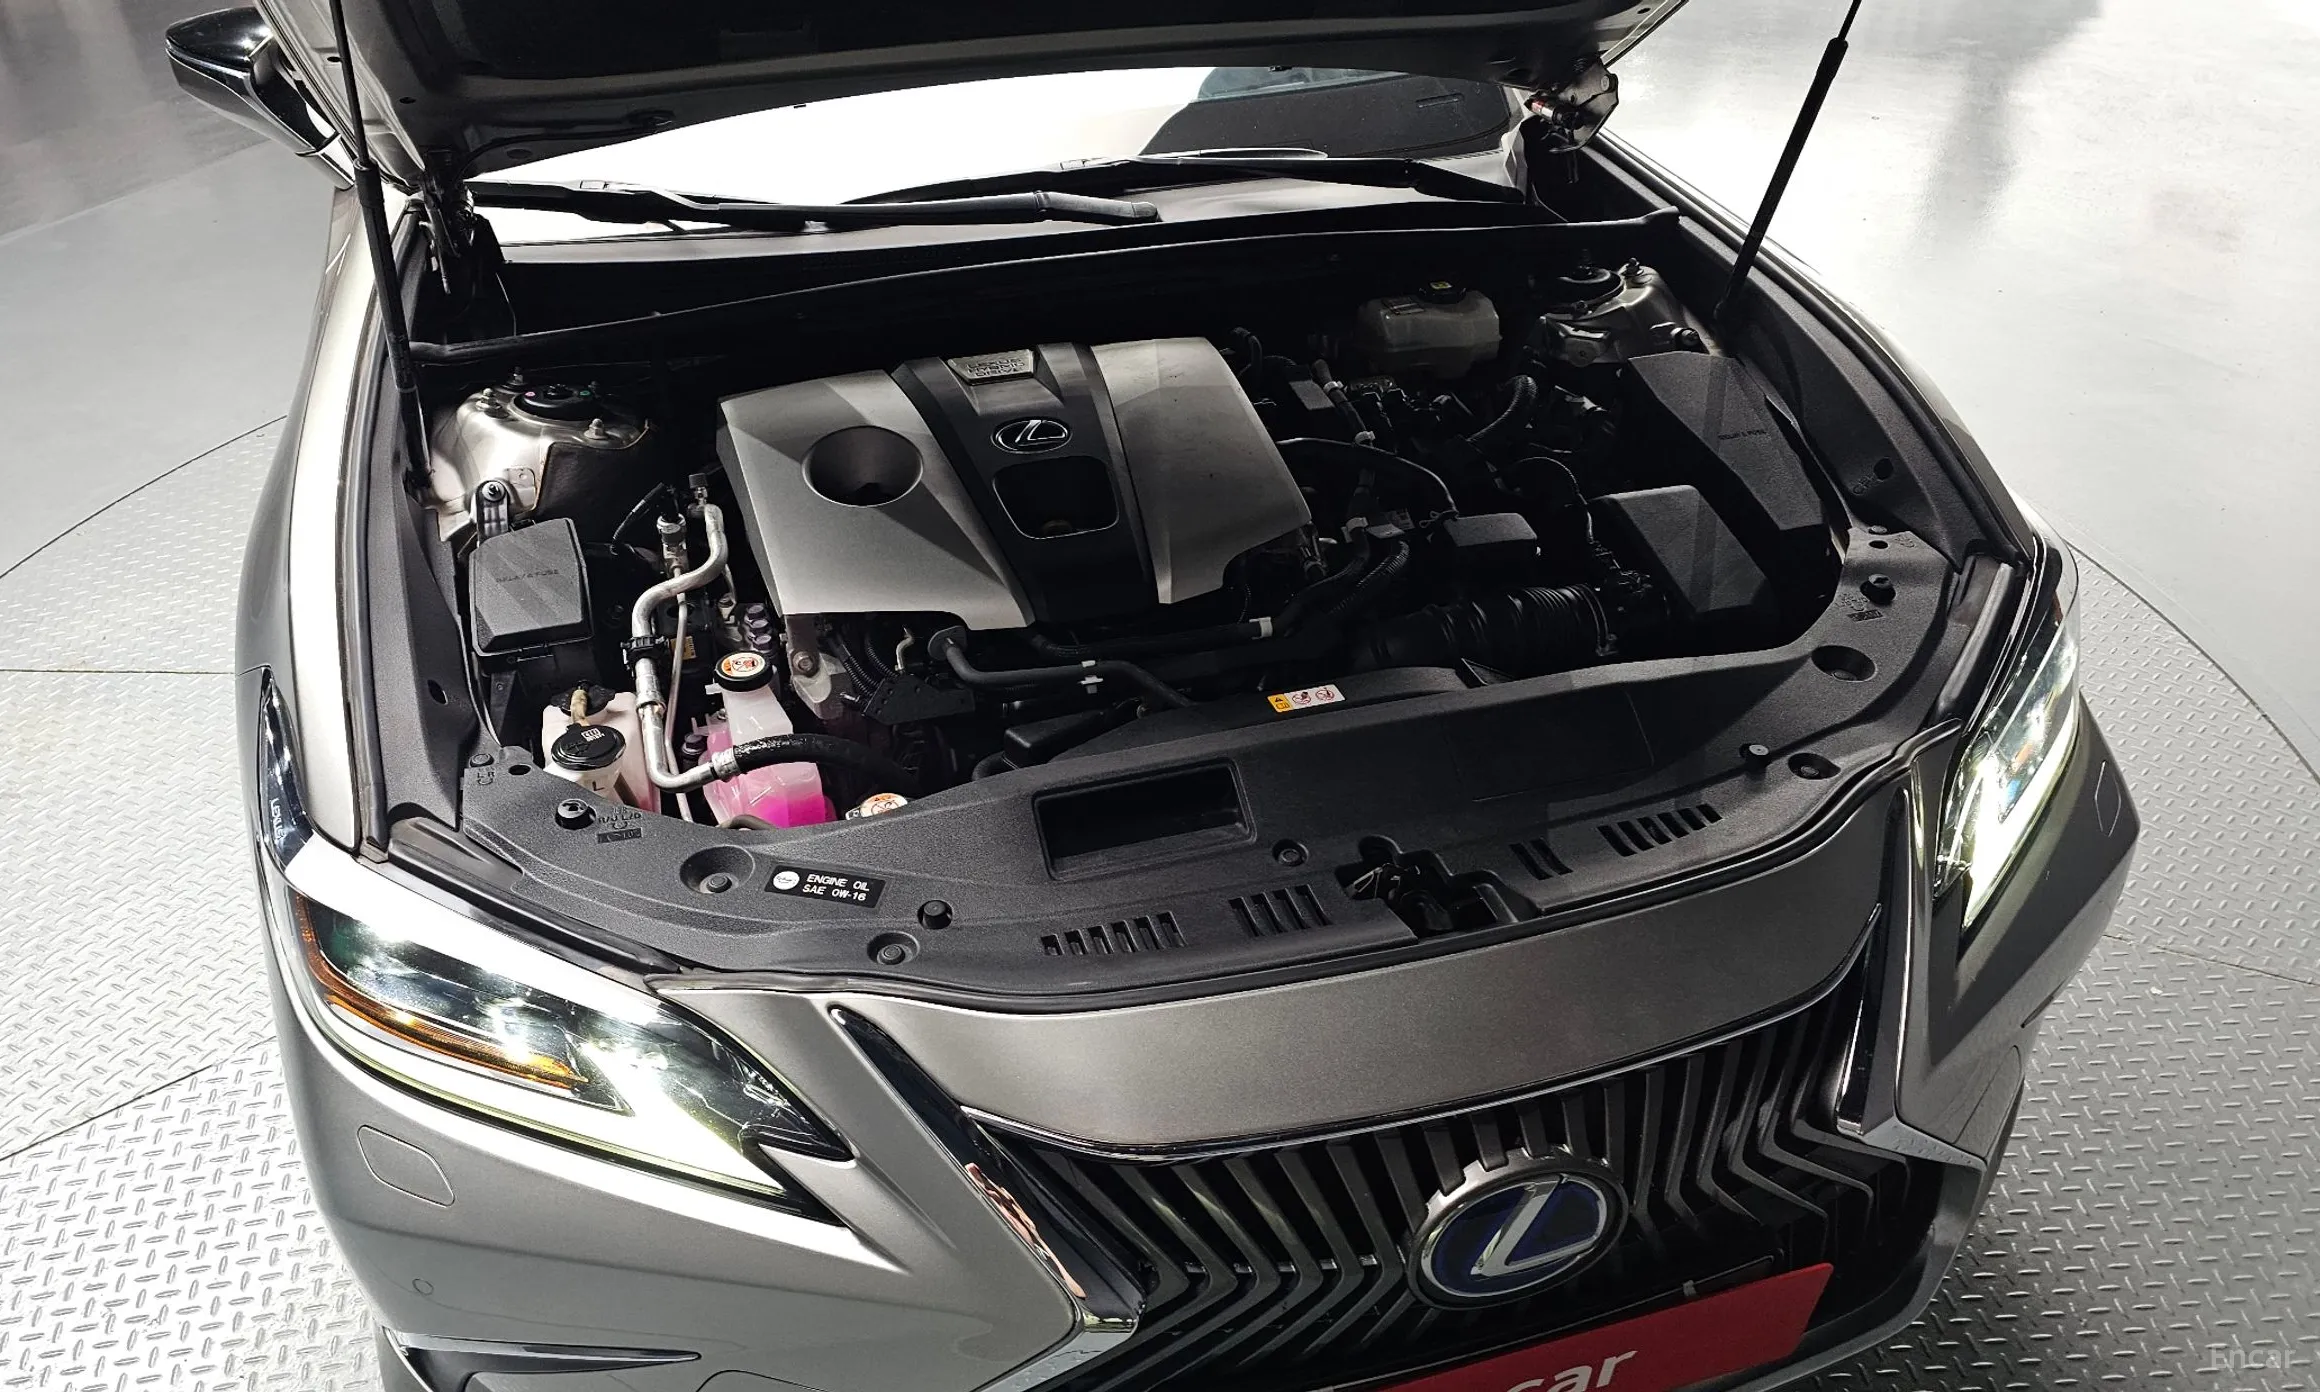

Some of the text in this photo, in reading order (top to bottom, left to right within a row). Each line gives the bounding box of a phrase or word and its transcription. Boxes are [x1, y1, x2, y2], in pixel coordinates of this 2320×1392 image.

[806, 873, 848, 887] ENGINE
[853, 881, 870, 891] OIL
[802, 884, 867, 901] SAE 0W-16
